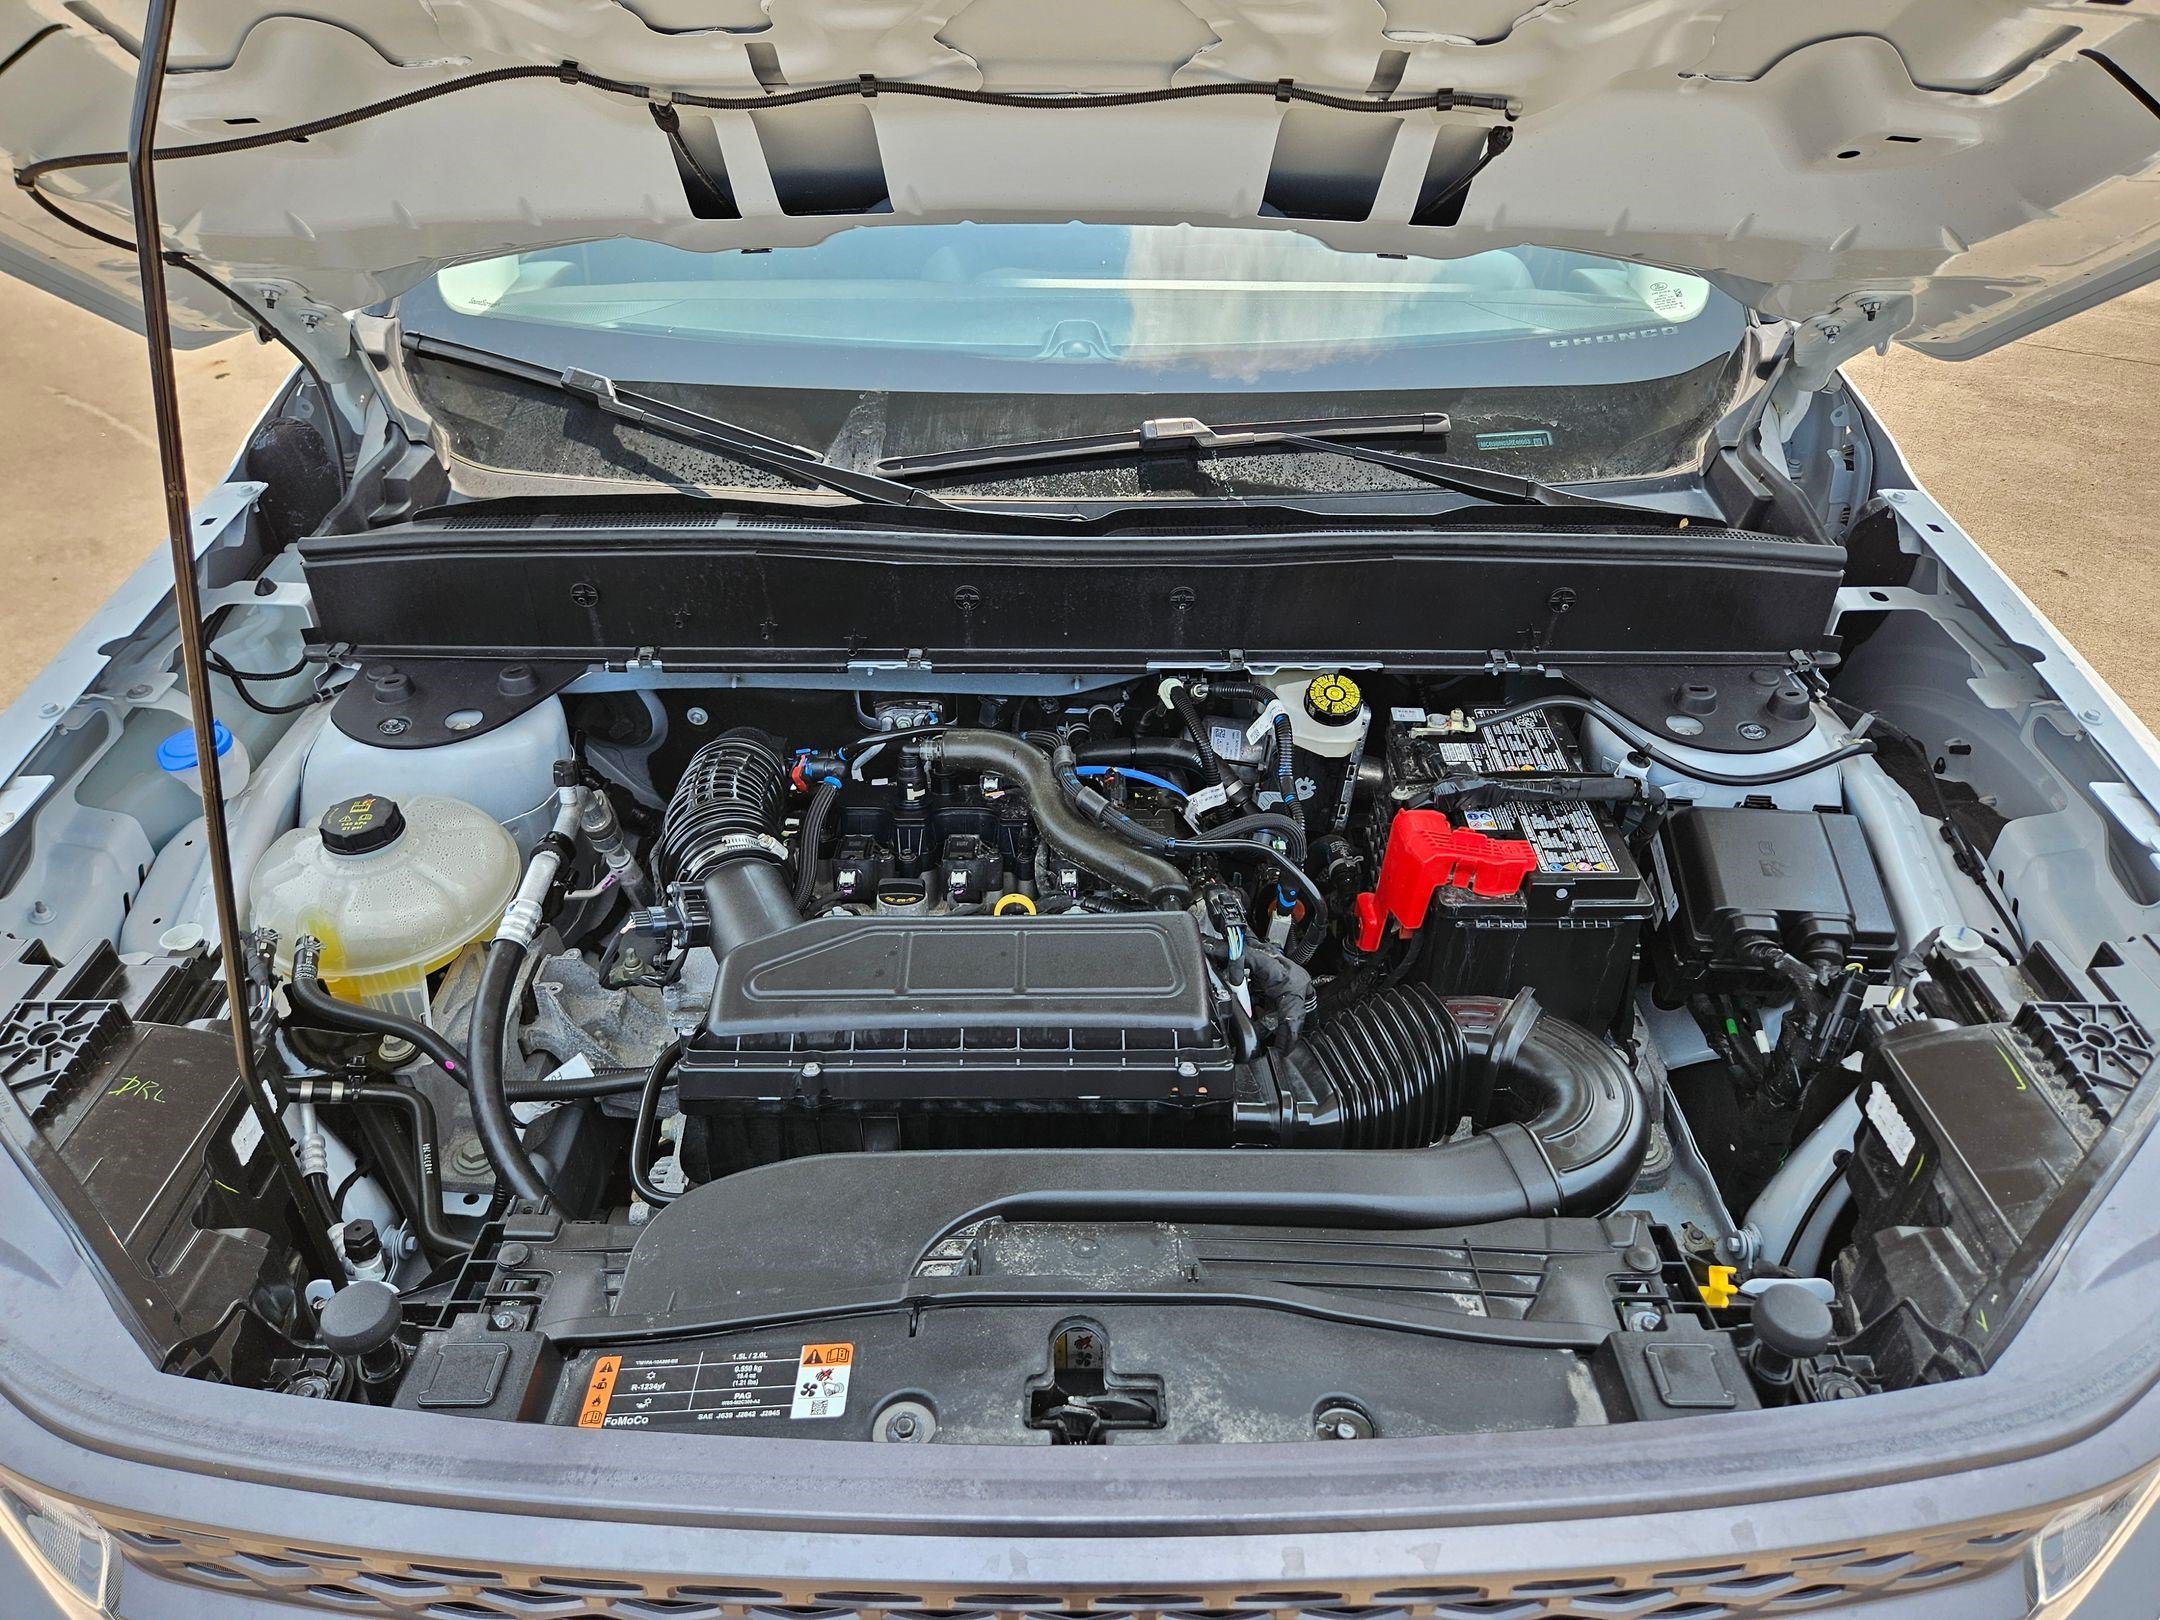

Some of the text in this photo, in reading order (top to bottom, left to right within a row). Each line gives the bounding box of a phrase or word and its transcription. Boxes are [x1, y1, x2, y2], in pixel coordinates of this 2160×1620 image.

[753, 1365, 763, 1374] kg
[631, 1382, 666, 1391] R-1234yf
[734, 1392, 752, 1400] PAG
[604, 1416, 649, 1426] FoMoCo
